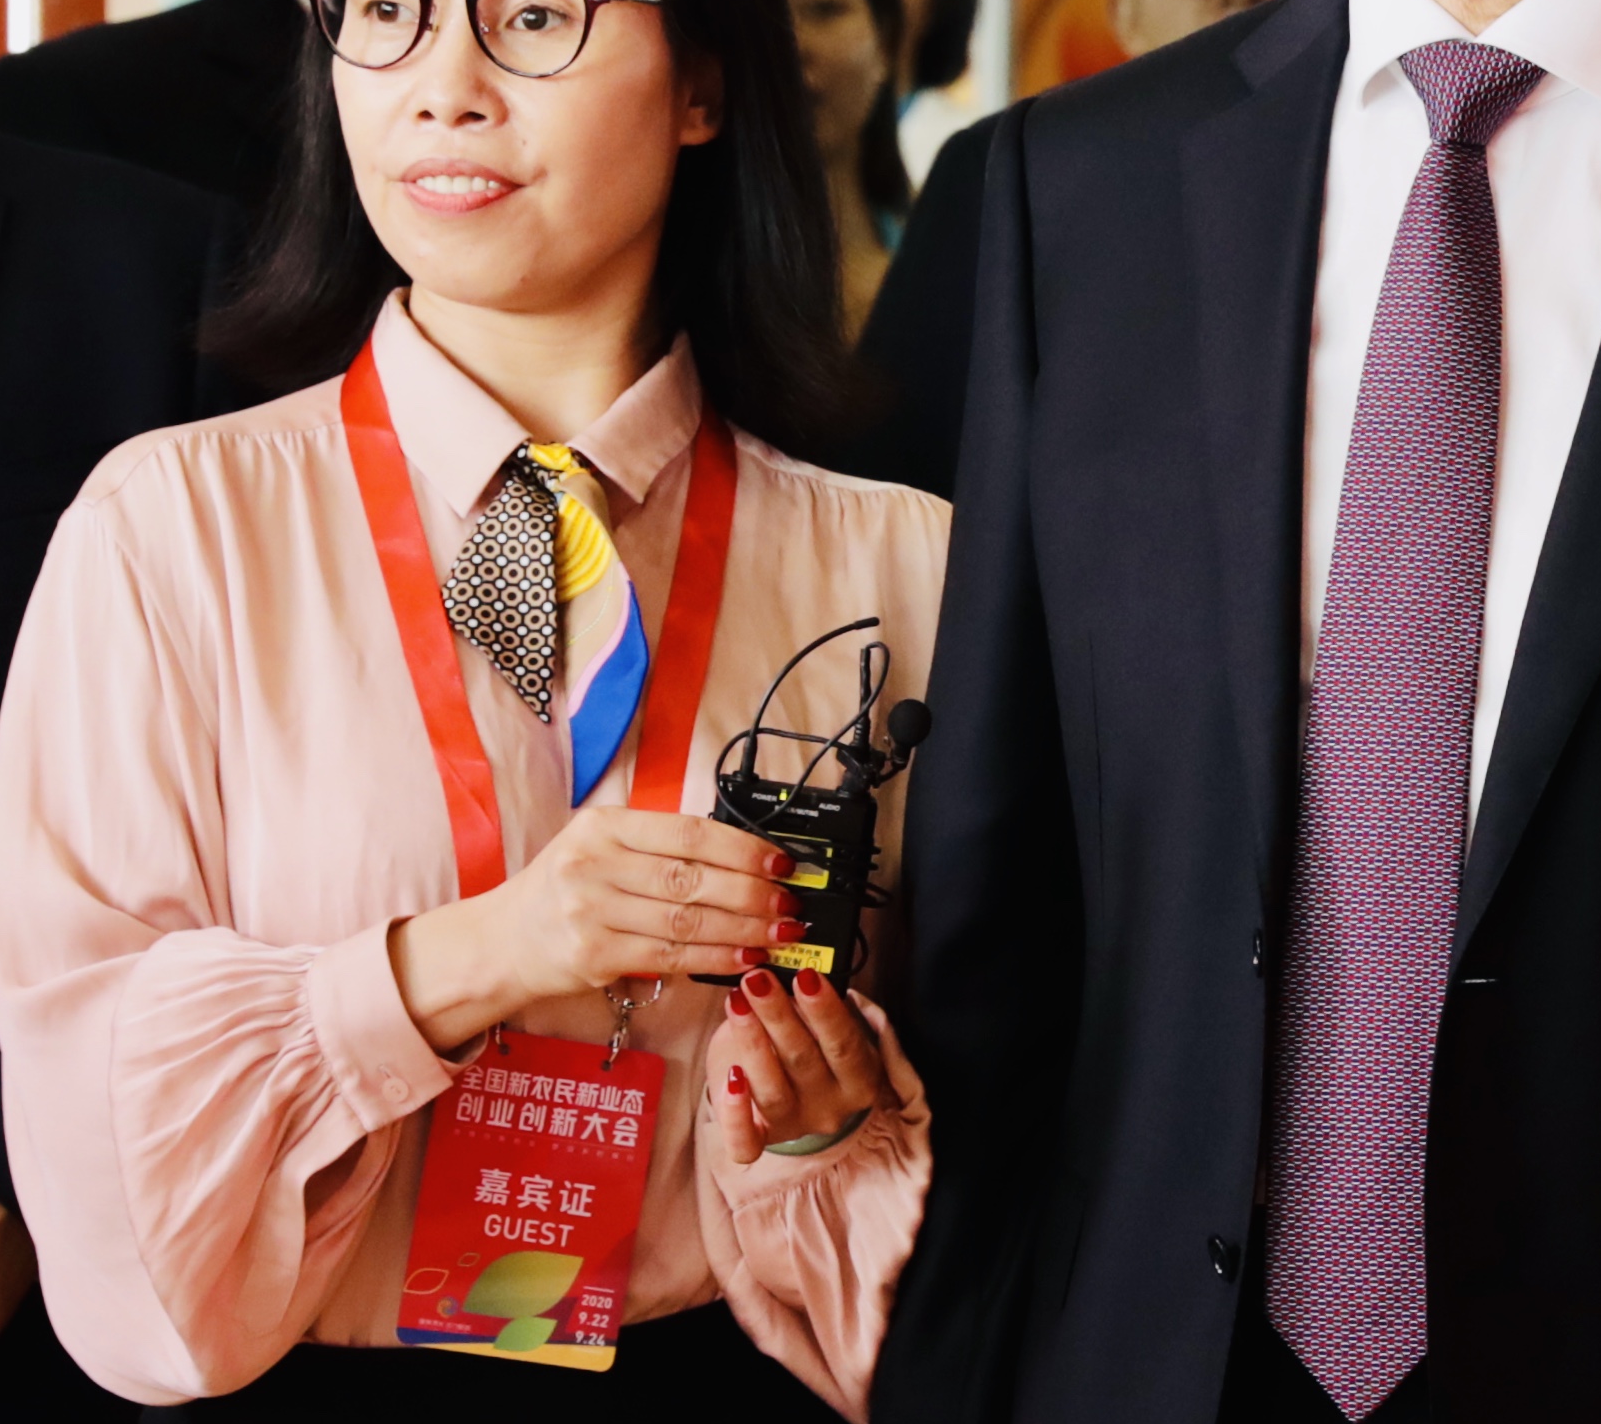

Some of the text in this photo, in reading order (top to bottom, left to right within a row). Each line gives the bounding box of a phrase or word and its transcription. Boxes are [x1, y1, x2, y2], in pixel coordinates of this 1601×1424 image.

[818, 802, 841, 811] AUDIO
[460, 1065, 646, 1116] 全国新农民新业态
[456, 1093, 639, 1148] 创业创新大会
[474, 1168, 596, 1217] 嘉宾证
[484, 1214, 574, 1247] GUEST
[581, 1294, 613, 1309] 2020
[578, 1312, 610, 1328] 9.22
[575, 1331, 606, 1347] 9.24
